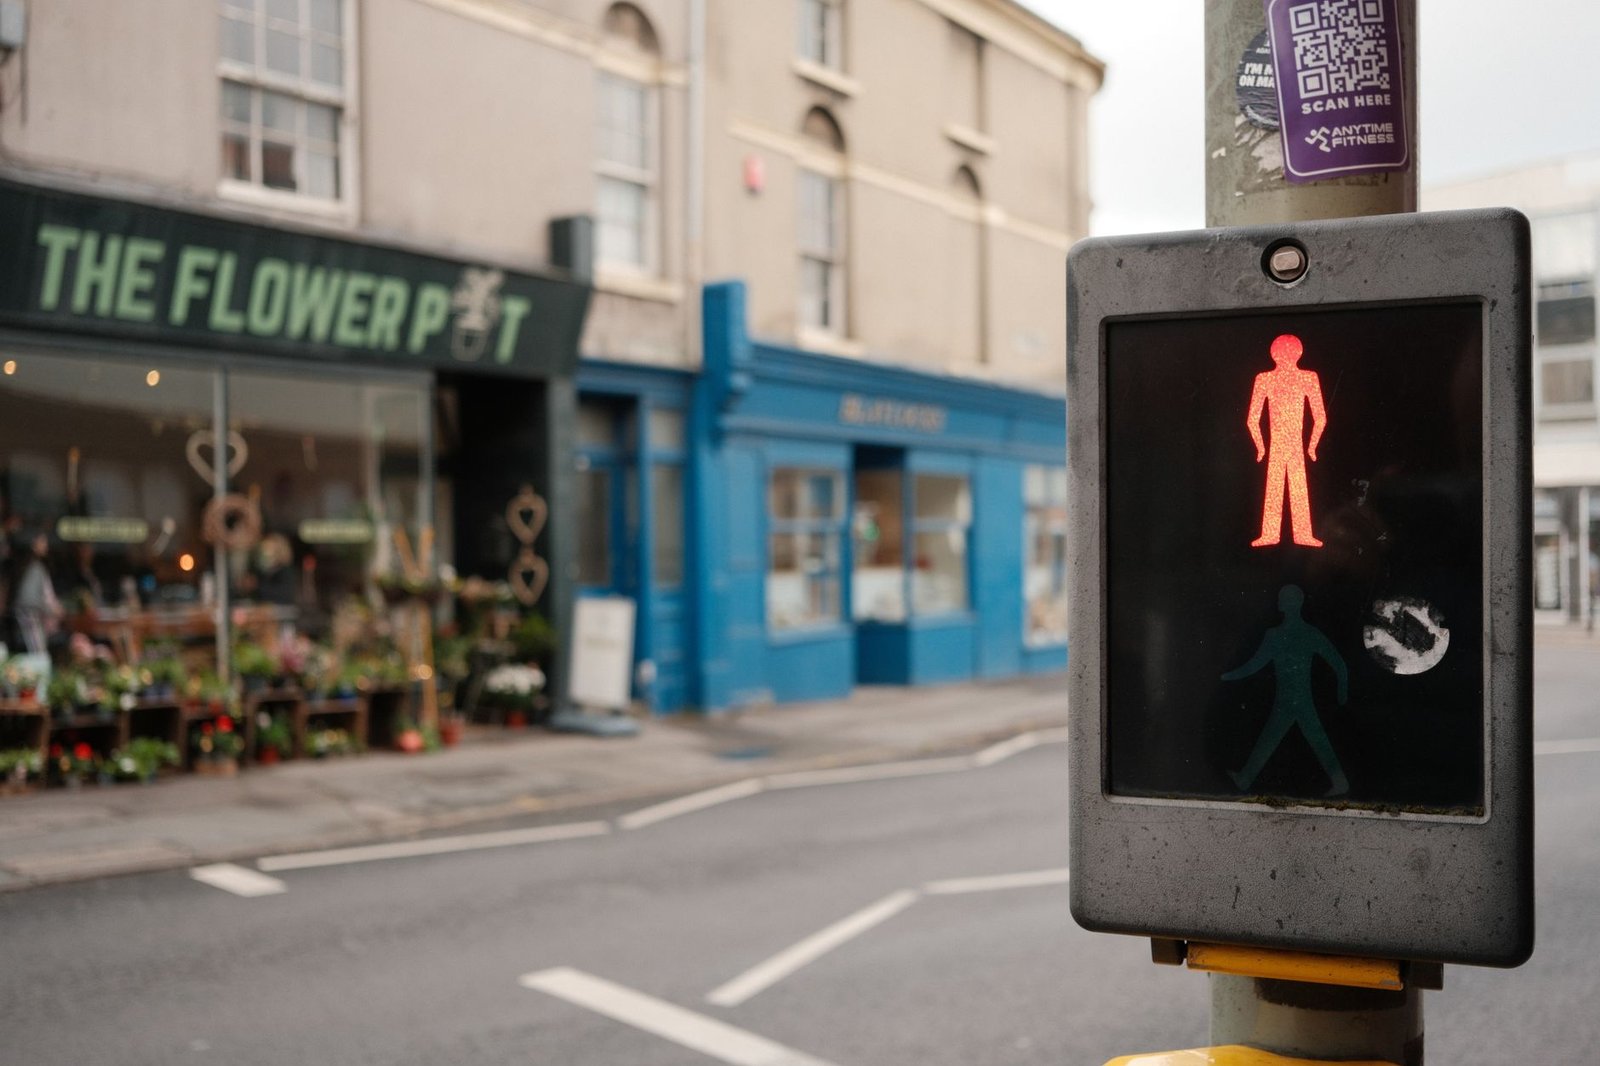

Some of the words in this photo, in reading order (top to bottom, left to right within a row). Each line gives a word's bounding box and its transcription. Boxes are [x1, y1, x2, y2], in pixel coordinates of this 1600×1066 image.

[1255, 76, 1275, 88] MA
[1301, 97, 1349, 115] SCAN
[1354, 94, 1391, 107] HERE
[1331, 123, 1393, 137] ANYTIME
[1332, 134, 1394, 148] FITNESS
[38, 223, 166, 321] THE
[168, 245, 410, 351] FLOWER
[408, 281, 531, 363] PT
